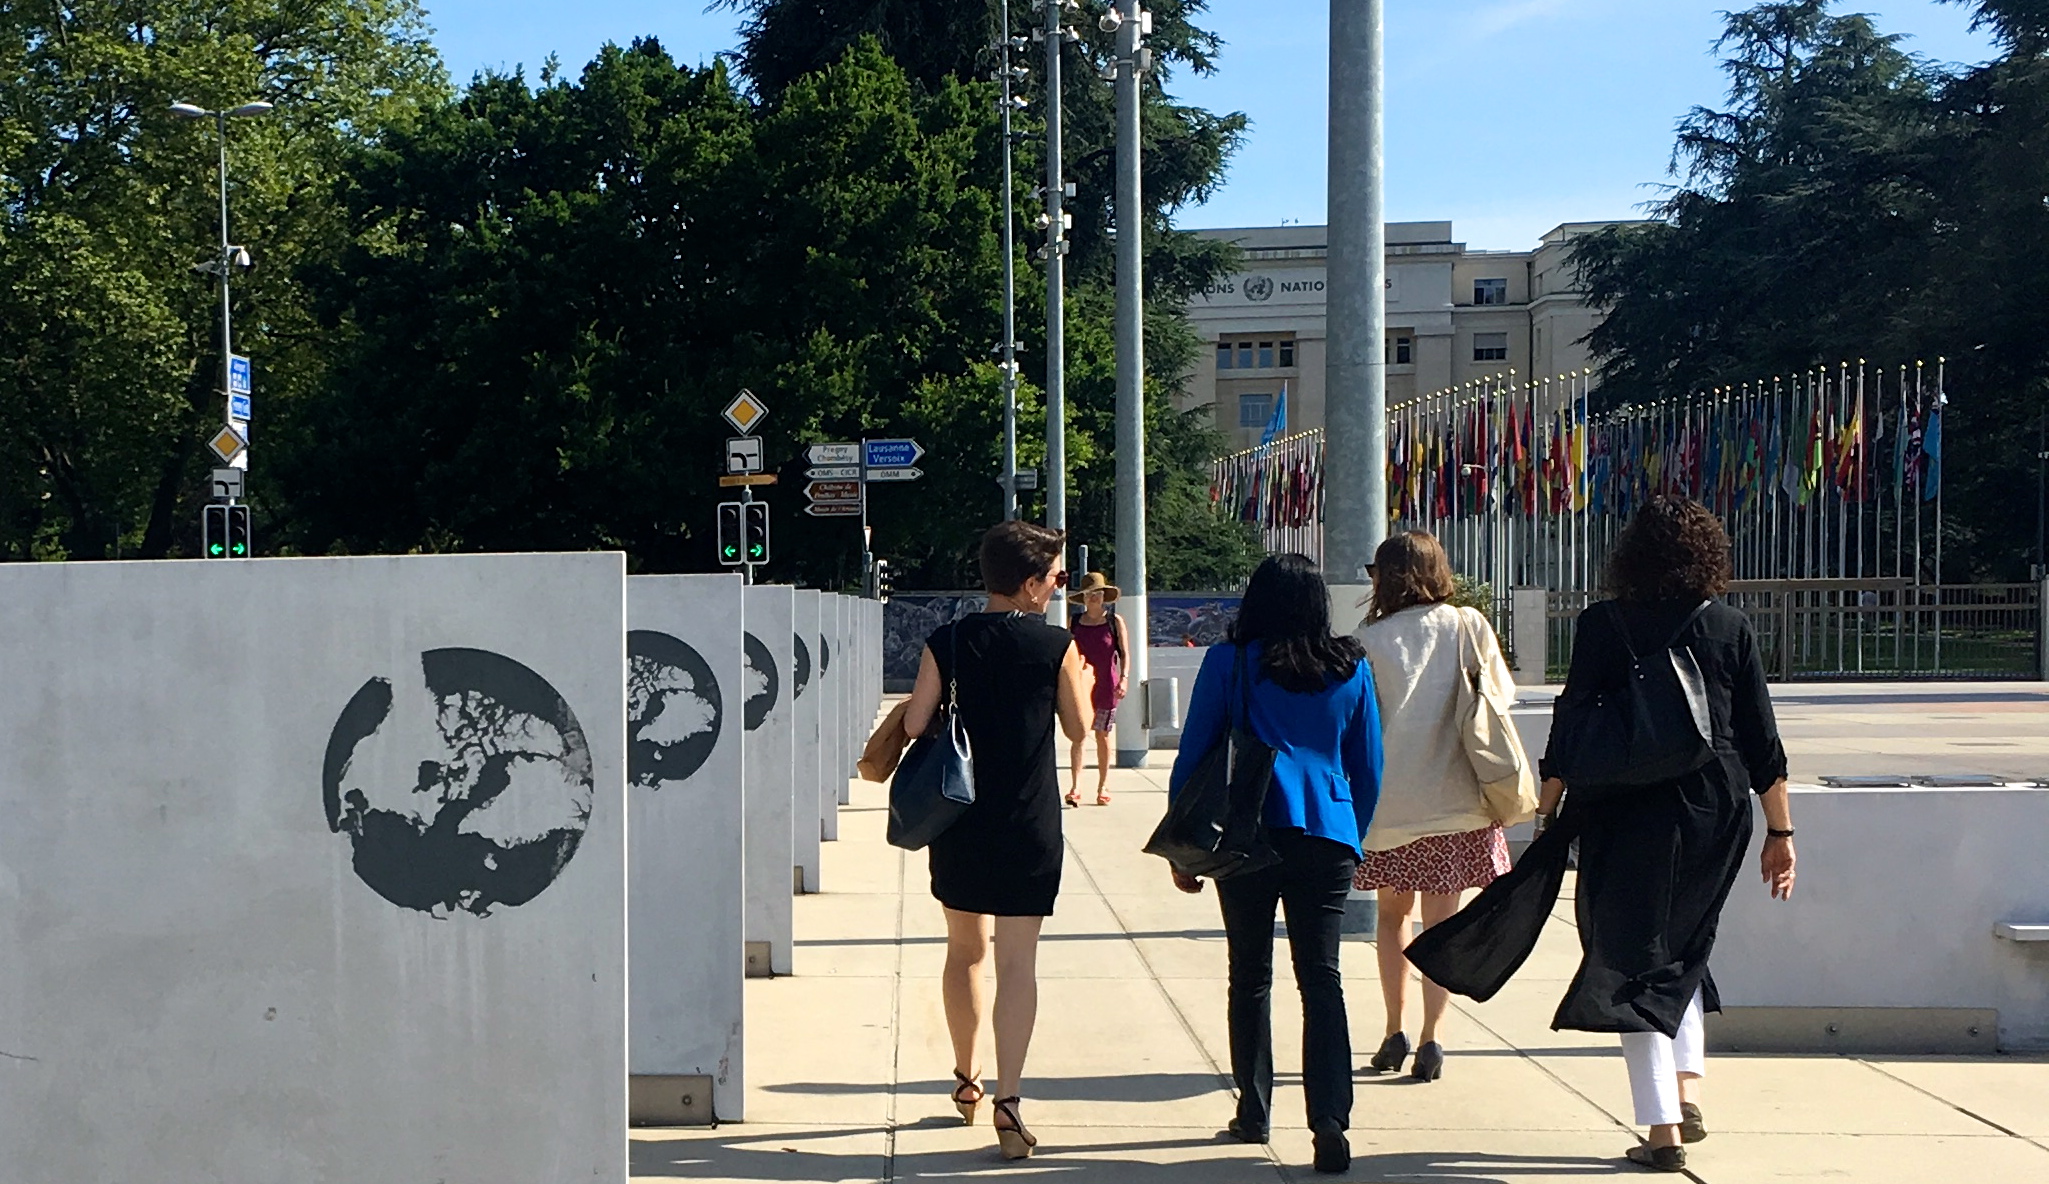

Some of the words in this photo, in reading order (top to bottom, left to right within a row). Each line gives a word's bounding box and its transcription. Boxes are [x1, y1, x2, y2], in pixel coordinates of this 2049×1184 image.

[1280, 280, 1325, 293] NATIO
[822, 446, 848, 455] Pregny
[868, 444, 910, 453] Lausanne
[873, 454, 905, 463] Versoix
[880, 470, 900, 478] OMM
